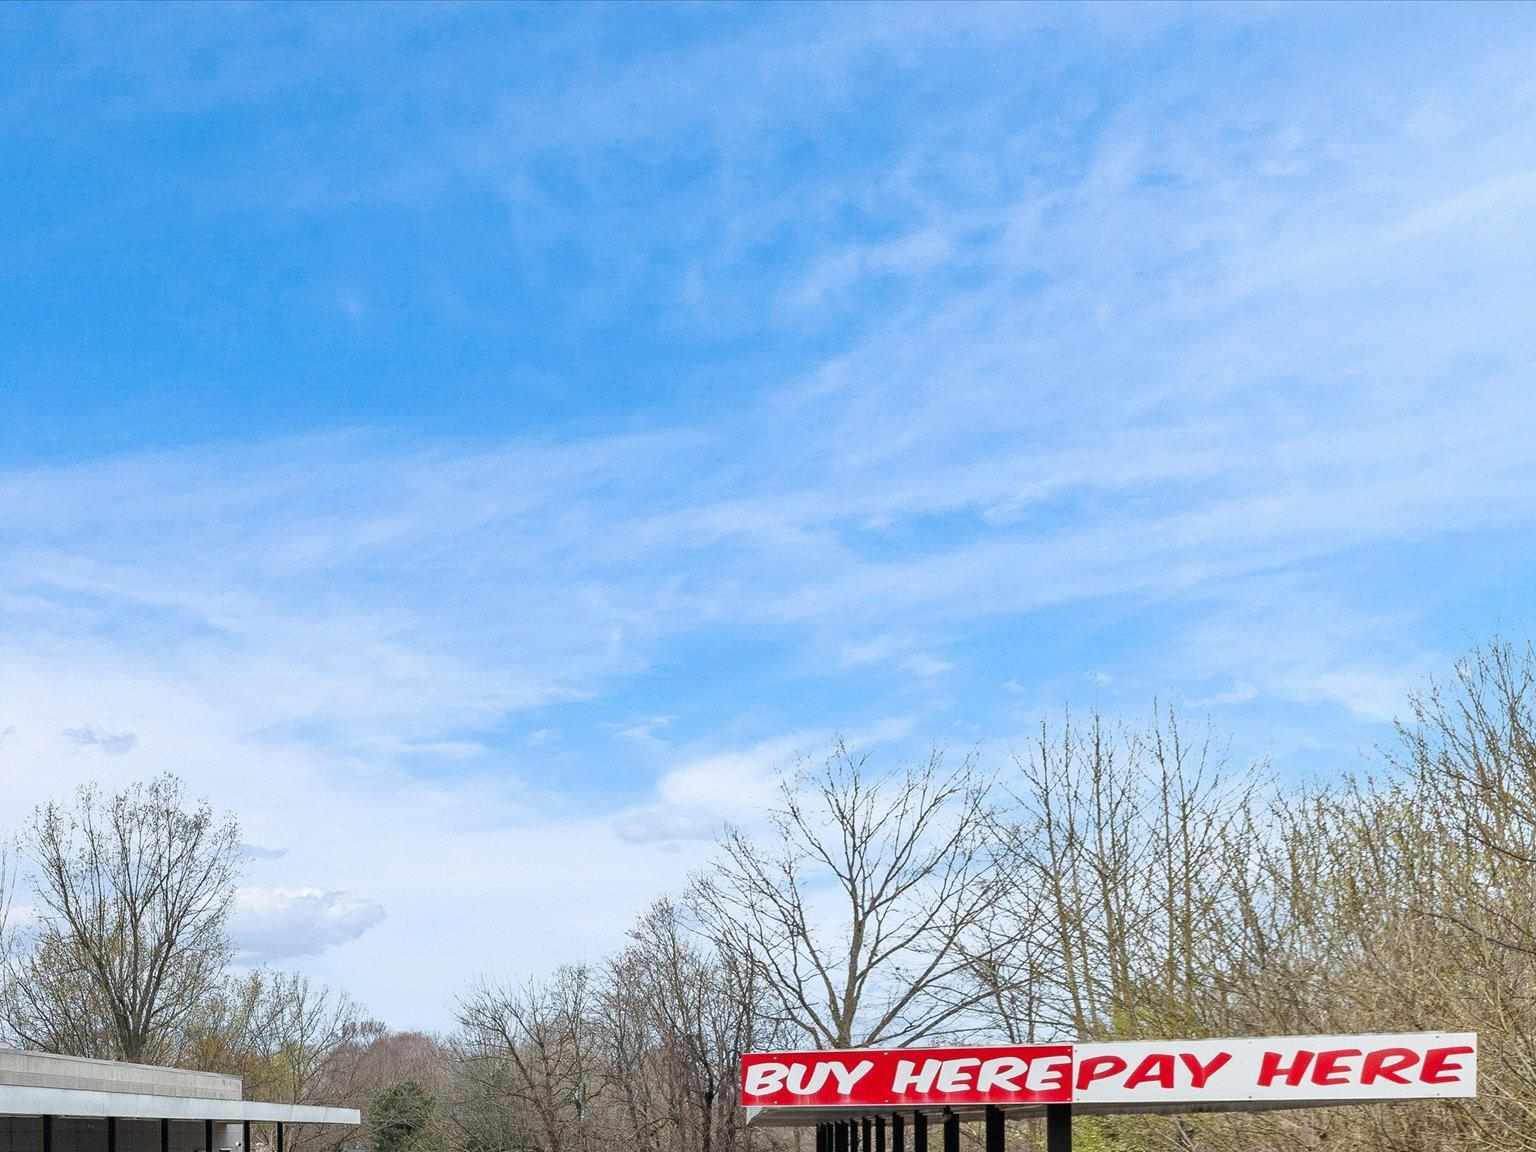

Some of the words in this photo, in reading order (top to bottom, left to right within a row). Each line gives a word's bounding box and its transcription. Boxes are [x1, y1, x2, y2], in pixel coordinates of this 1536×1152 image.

[744, 1059, 874, 1096] BUY
[891, 1055, 1071, 1094] HERE
[1075, 1052, 1233, 1090] PAY
[1257, 1046, 1474, 1087] HERE
